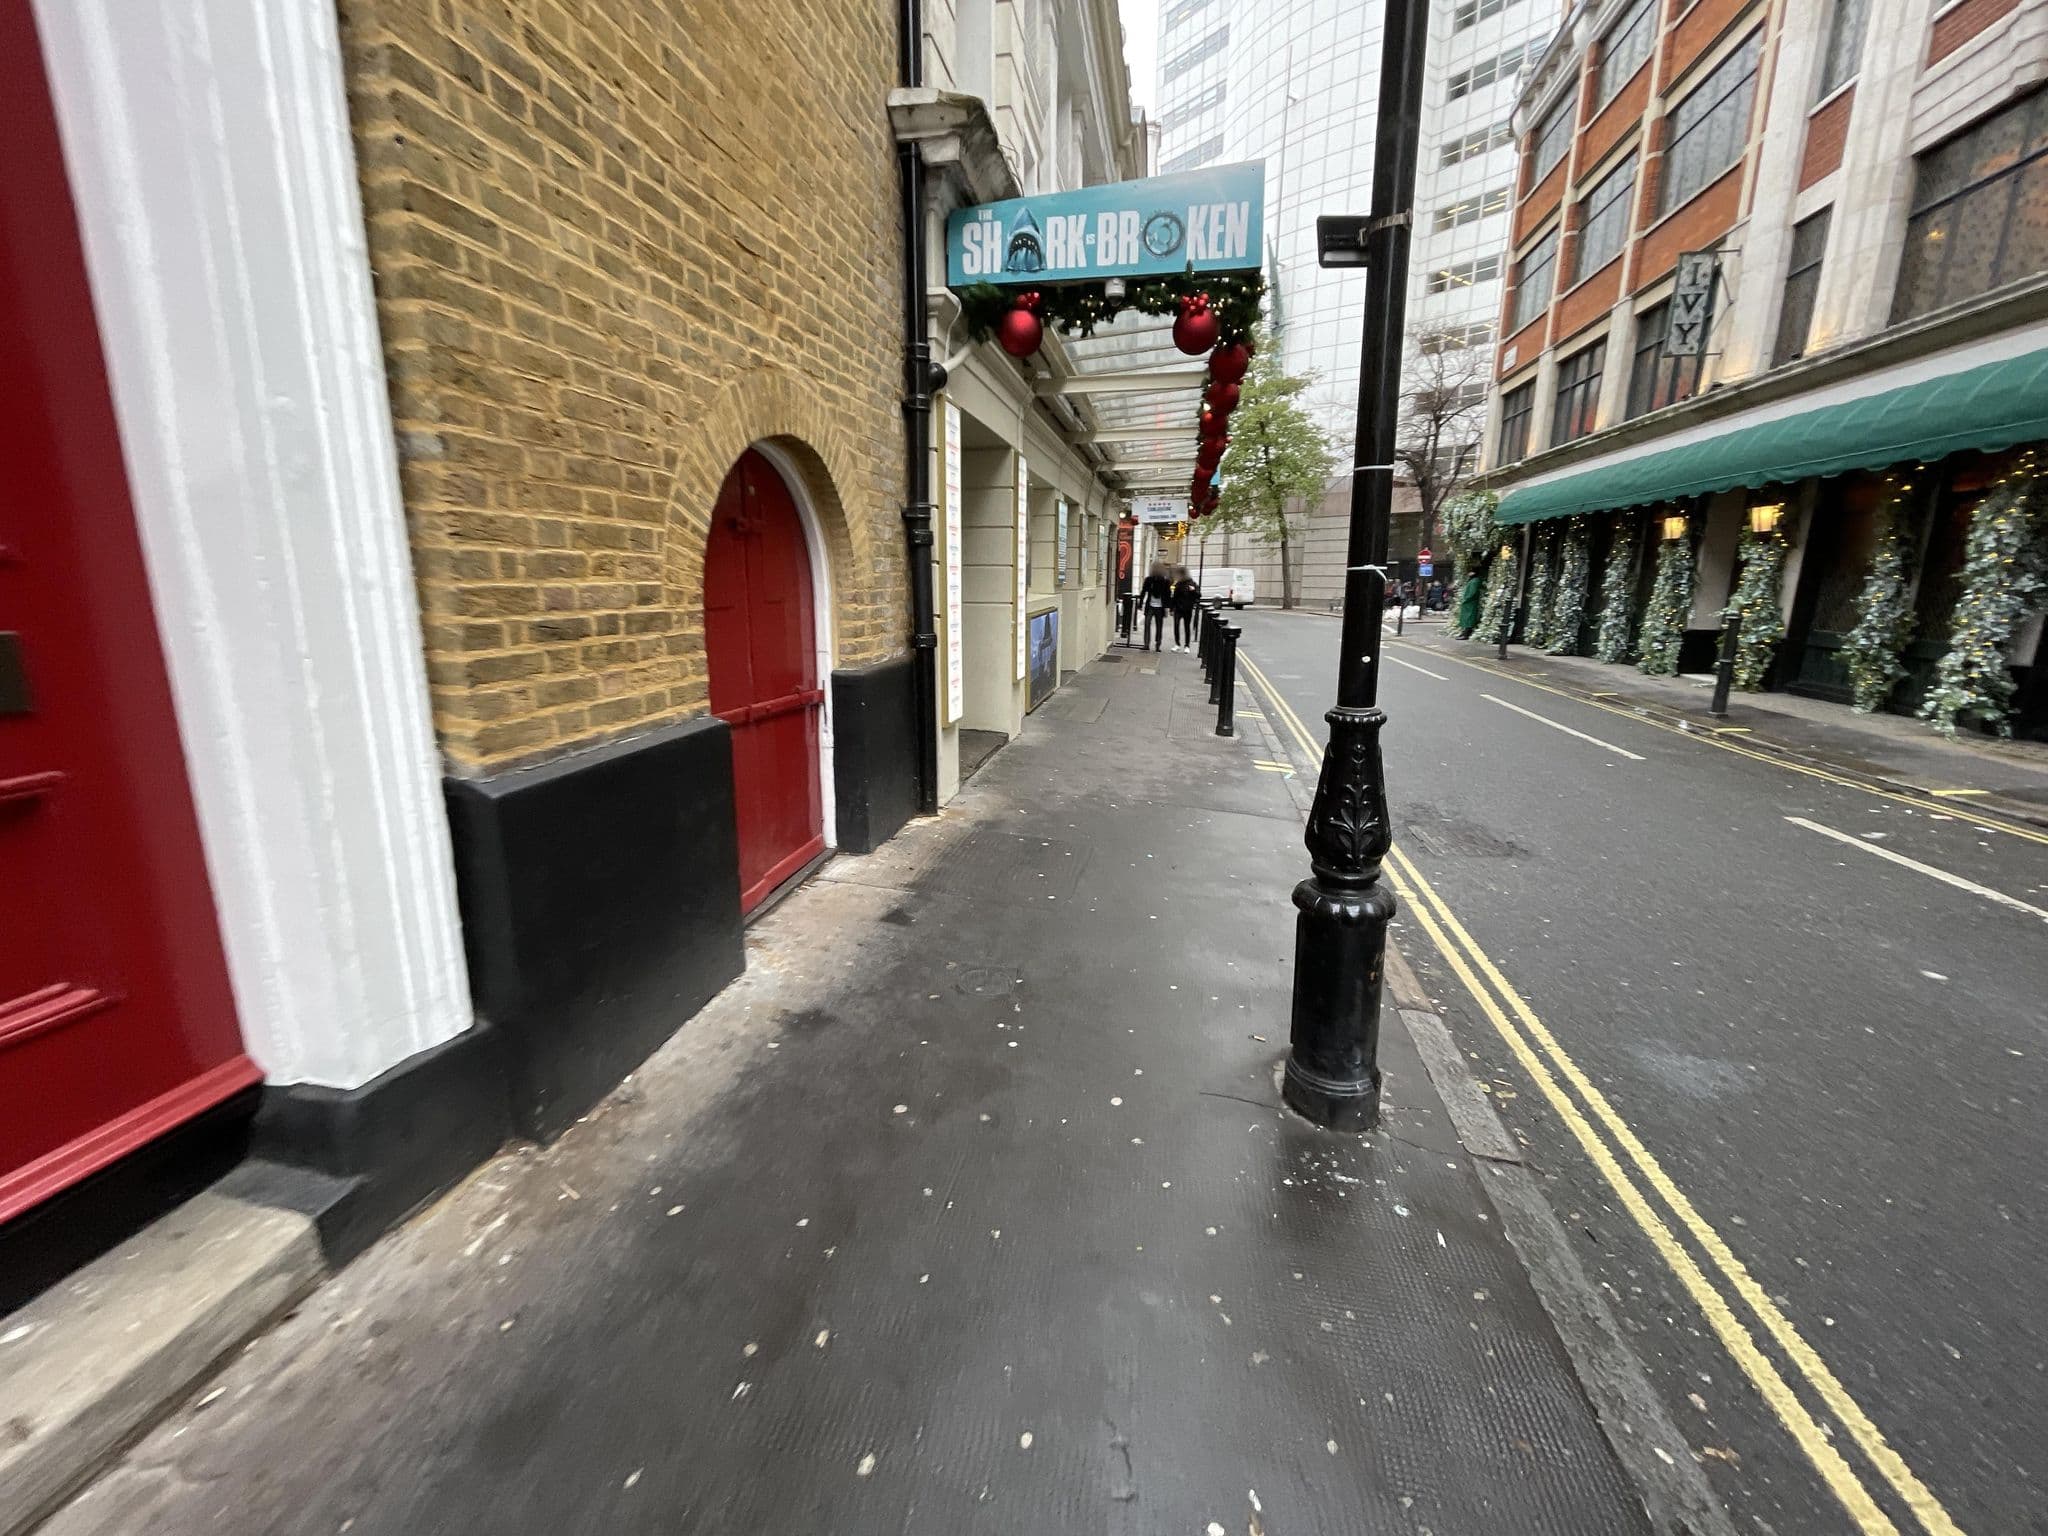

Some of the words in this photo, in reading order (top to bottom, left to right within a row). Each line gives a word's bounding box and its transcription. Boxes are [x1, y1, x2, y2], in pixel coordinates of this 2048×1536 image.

[978, 209, 993, 221] THE
[1085, 233, 1096, 245] IS
[1097, 201, 1250, 267] BROKEN
[1673, 262, 1706, 346] IVY
